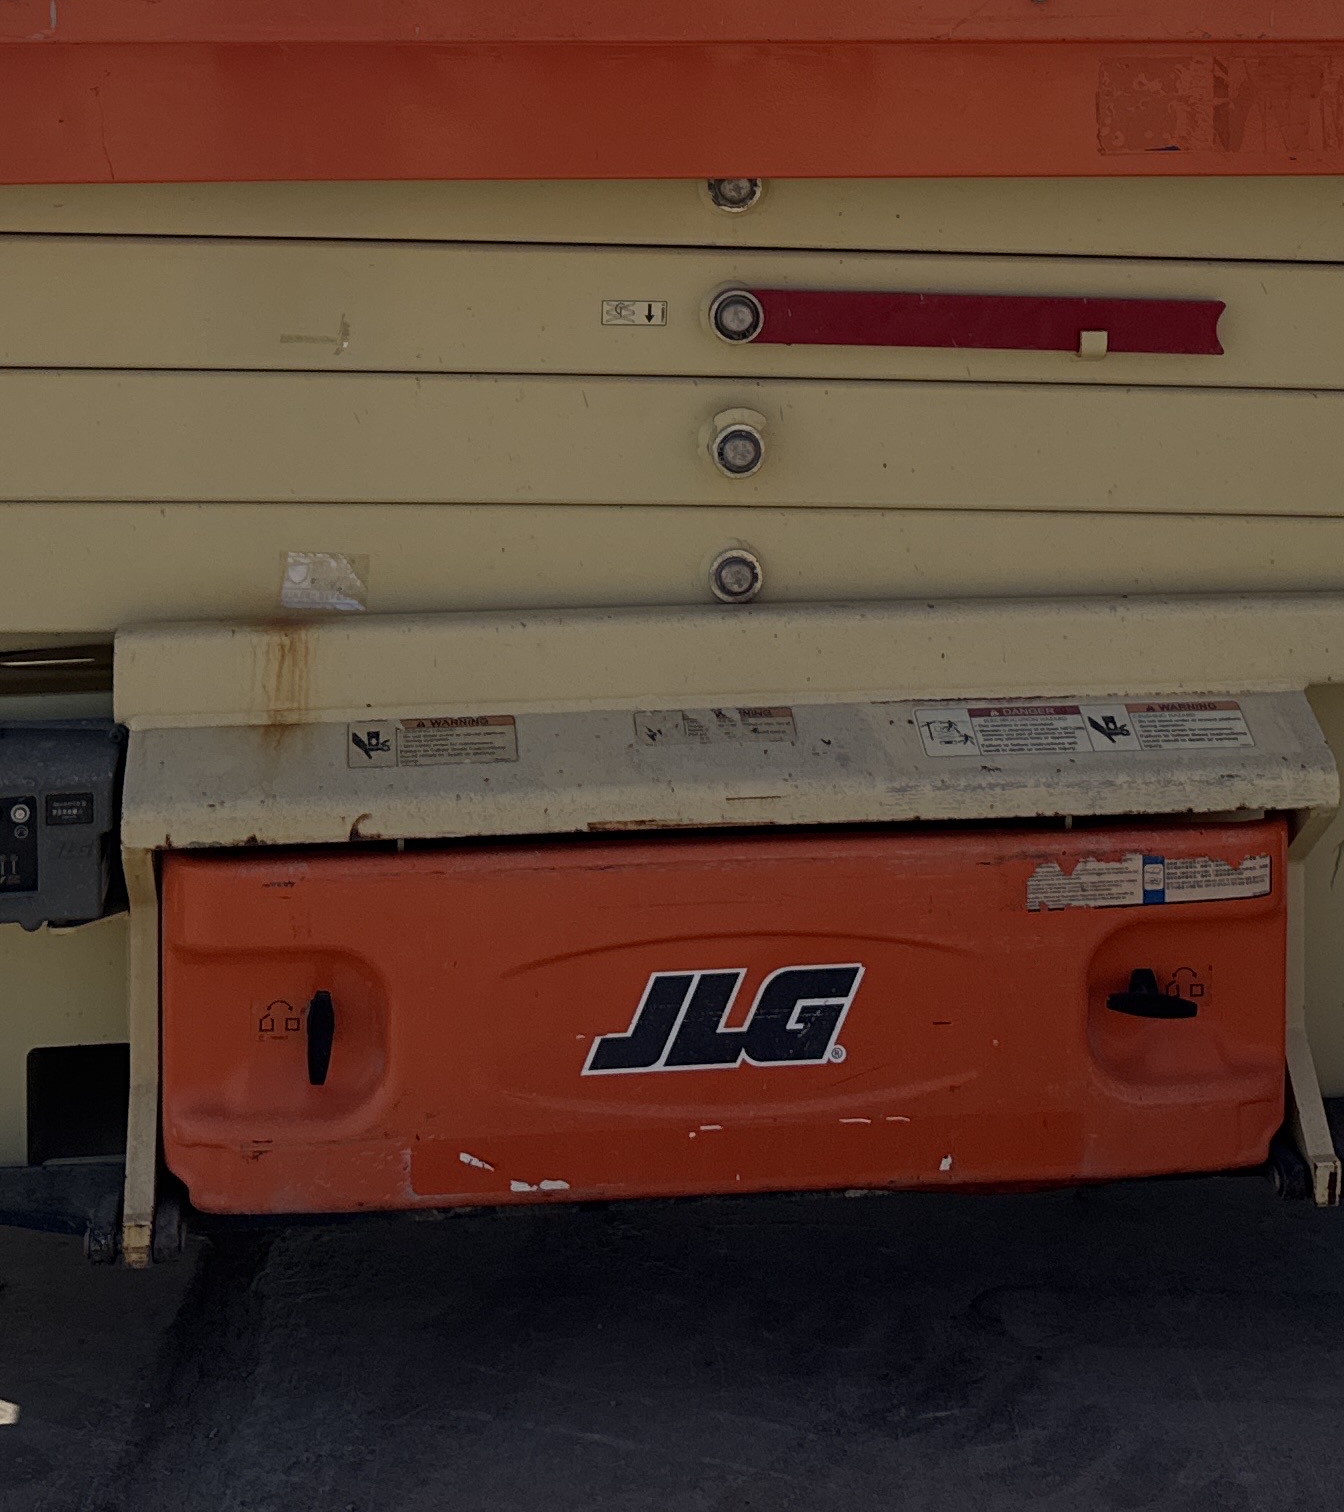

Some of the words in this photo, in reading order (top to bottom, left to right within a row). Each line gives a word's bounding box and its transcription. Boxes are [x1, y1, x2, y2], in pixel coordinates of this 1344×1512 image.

[1003, 707, 1055, 716] DANGER
[1158, 702, 1217, 712] WARNING
[429, 718, 489, 728] WARNING
[581, 963, 865, 1076] JLG
